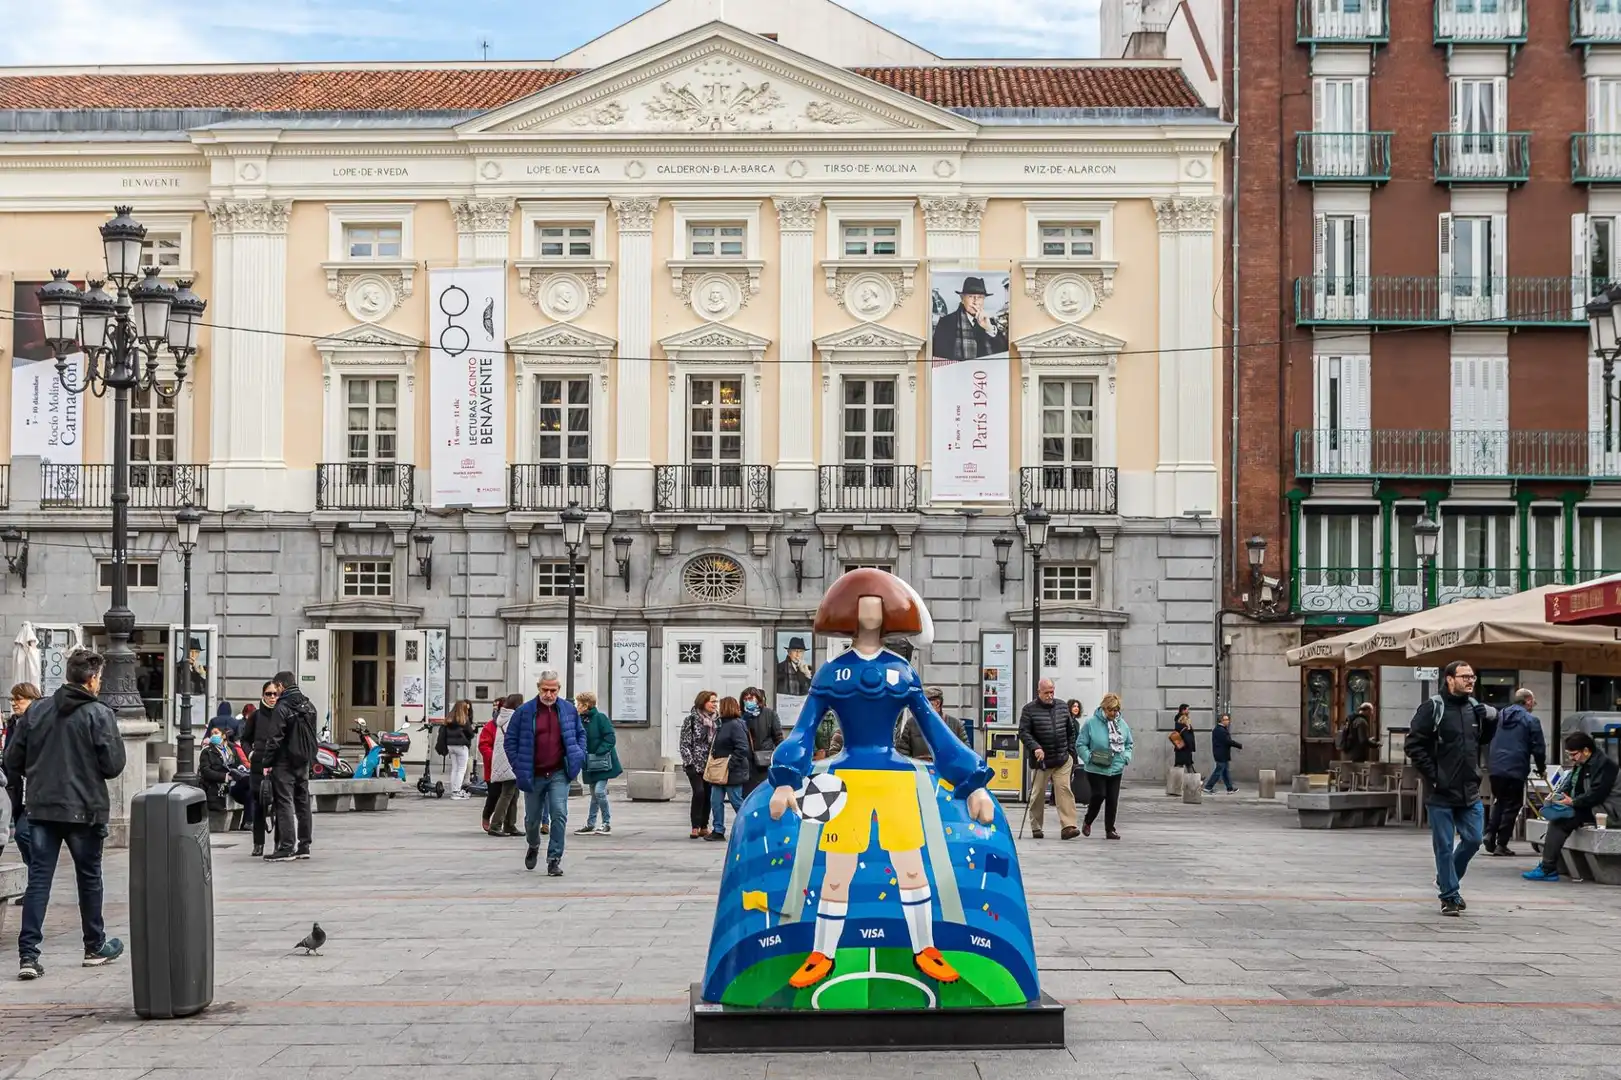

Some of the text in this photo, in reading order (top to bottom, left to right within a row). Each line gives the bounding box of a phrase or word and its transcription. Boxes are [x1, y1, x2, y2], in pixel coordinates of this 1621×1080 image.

[122, 178, 180, 188] BENAVENTE
[469, 357, 478, 446] LECTURAS JACINTO
[480, 358, 493, 444] BENAVENTE
[48, 376, 59, 446] Rocío Molina
[972, 370, 988, 450] París 1940
[1432, 631, 1460, 648] VINOTECA
[835, 668, 851, 682] 10
[826, 833, 838, 843] 10
[860, 928, 885, 938] VISA
[758, 934, 782, 948] VISA
[969, 934, 992, 949] VISA
